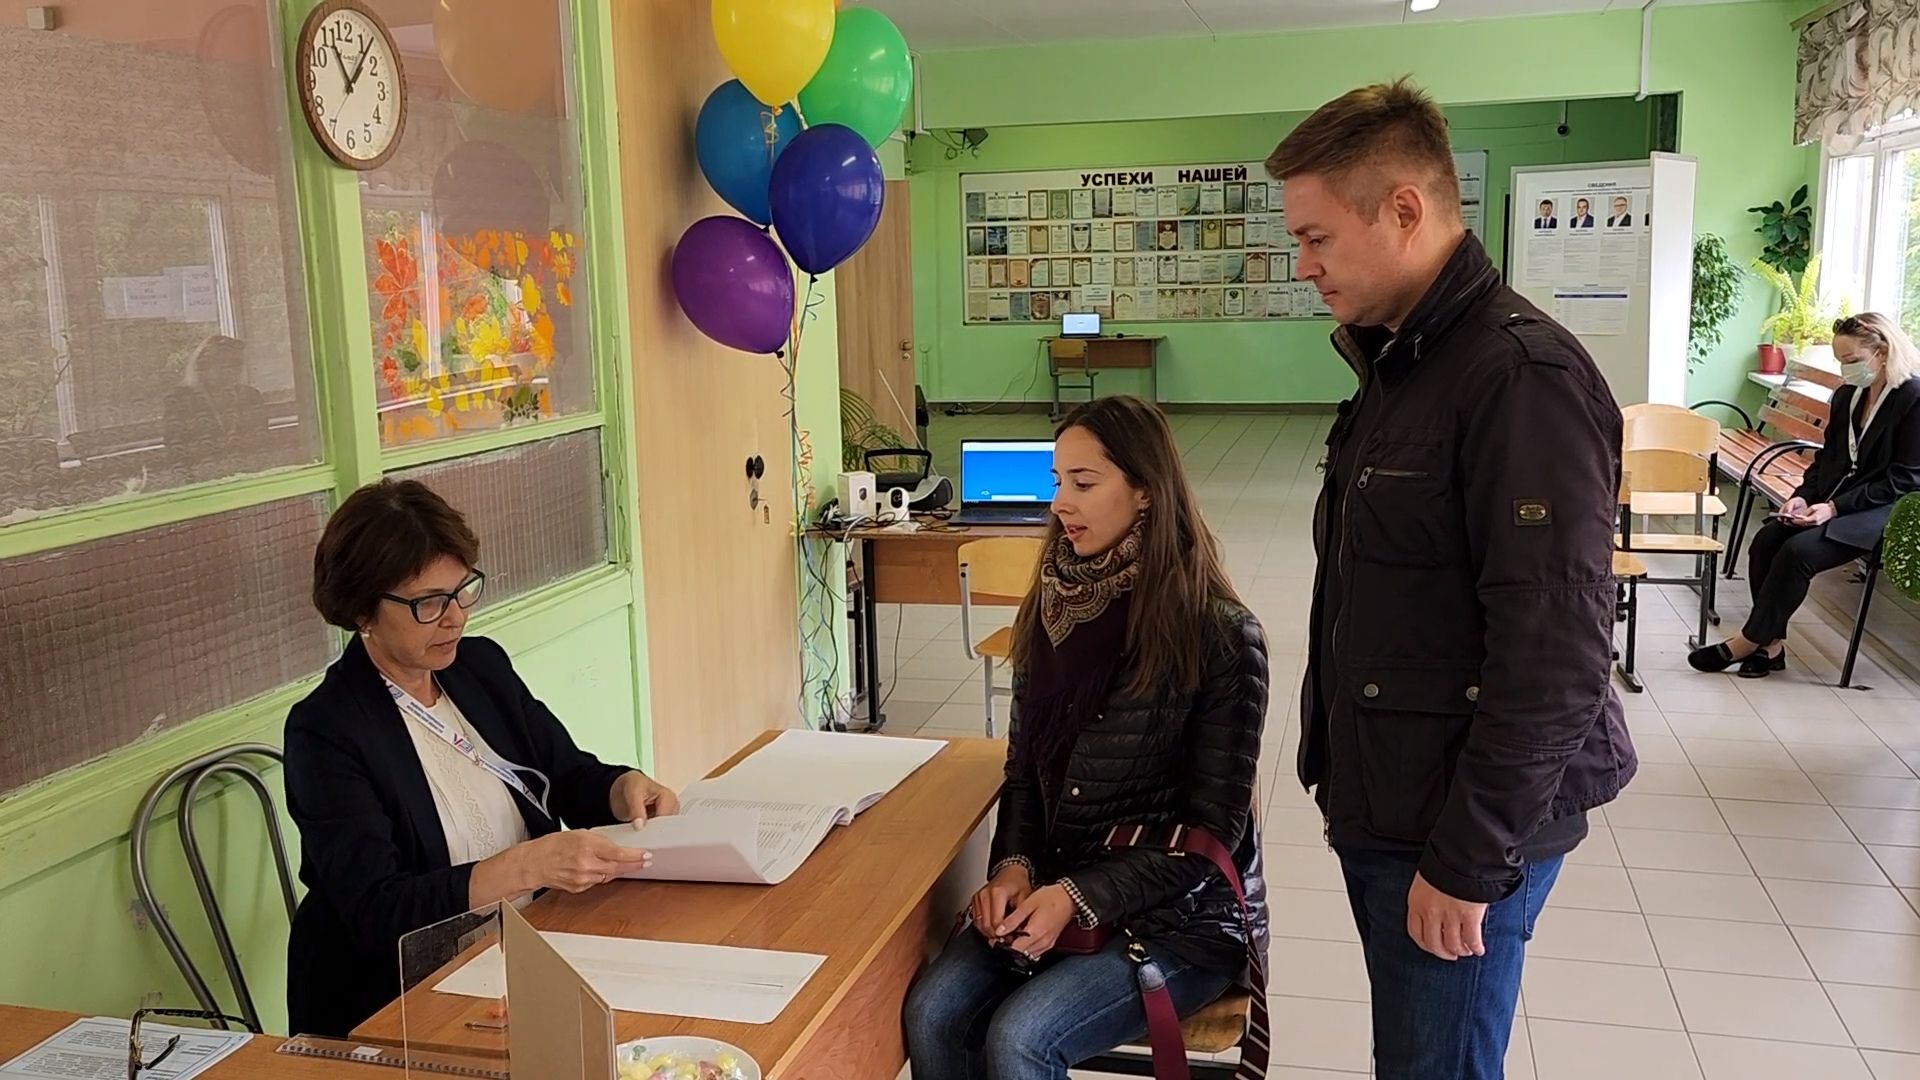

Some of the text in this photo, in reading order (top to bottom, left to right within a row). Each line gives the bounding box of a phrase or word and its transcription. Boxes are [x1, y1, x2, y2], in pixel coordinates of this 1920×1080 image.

[321, 26, 337, 49] 11
[334, 20, 353, 43] 12
[357, 33, 366, 54] 1
[312, 45, 327, 68] 10
[369, 55, 378, 77] 2
[310, 69, 316, 91] 9
[377, 81, 386, 101] 3
[315, 95, 325, 117] 8
[372, 104, 382, 124] 4
[329, 118, 338, 139] 7
[346, 129, 356, 150] 6
[363, 123, 372, 143] 5
[1081, 165, 1247, 187] УСПЕХИ НАШЕЙ
